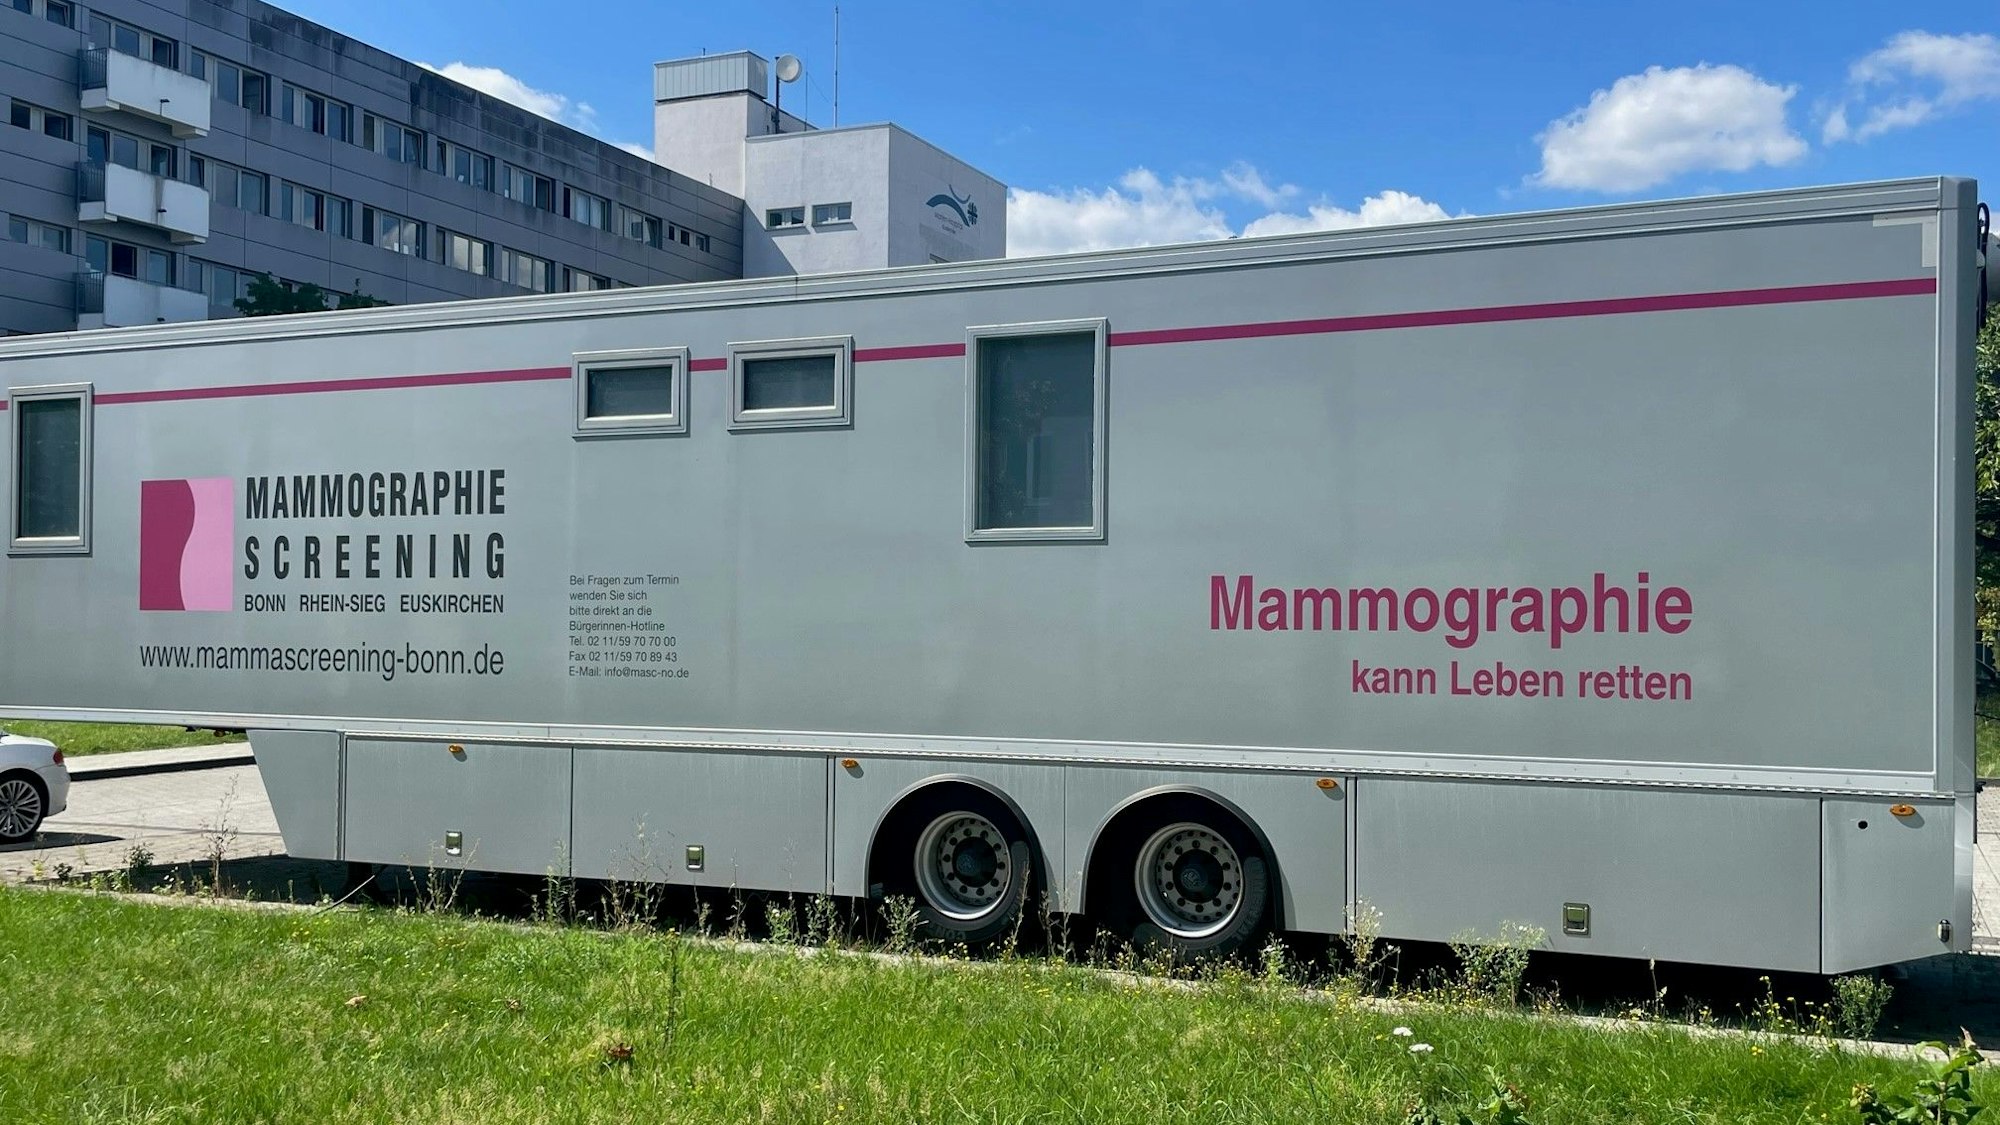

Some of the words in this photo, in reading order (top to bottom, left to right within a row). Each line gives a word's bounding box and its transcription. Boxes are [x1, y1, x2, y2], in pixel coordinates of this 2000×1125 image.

[246, 469, 505, 519] MAMMOGRAPHIE
[244, 532, 505, 579] SCREENING
[569, 575, 585, 586] Bei
[588, 575, 621, 588] Fragen
[623, 577, 644, 586] zum
[646, 574, 680, 585] Termin
[569, 590, 607, 600] wenden
[609, 589, 625, 601] Sie
[627, 590, 648, 600] sich
[244, 594, 286, 612] BONN
[299, 594, 386, 613] RHEIN-SIEG
[400, 594, 504, 614] EUSKIRCHEN
[569, 606, 590, 616] bitte
[592, 606, 620, 616] direkt
[622, 607, 635, 616] an
[637, 606, 653, 616] die
[1210, 571, 1693, 649] Mammographie
[569, 620, 666, 633] Bürgerinnen-Hotline
[569, 635, 585, 647] Tel.
[587, 636, 600, 647] 02
[603, 636, 631, 647] 11/59
[634, 636, 646, 647] 70
[649, 636, 661, 647] 70
[663, 636, 677, 647] 00
[139, 642, 505, 681] www.mammascreening-bonn.de
[569, 650, 586, 661] Fax
[588, 651, 601, 662] 02
[604, 651, 632, 662] 11/59
[635, 651, 648, 662] 70
[649, 652, 662, 662] 89
[665, 652, 678, 662] 43
[568, 666, 601, 677] E-Mail:
[604, 666, 690, 678] info@masc-no.de
[1352, 659, 1437, 695] kann
[1450, 661, 1565, 698] Leben
[1578, 665, 1693, 700] retten
